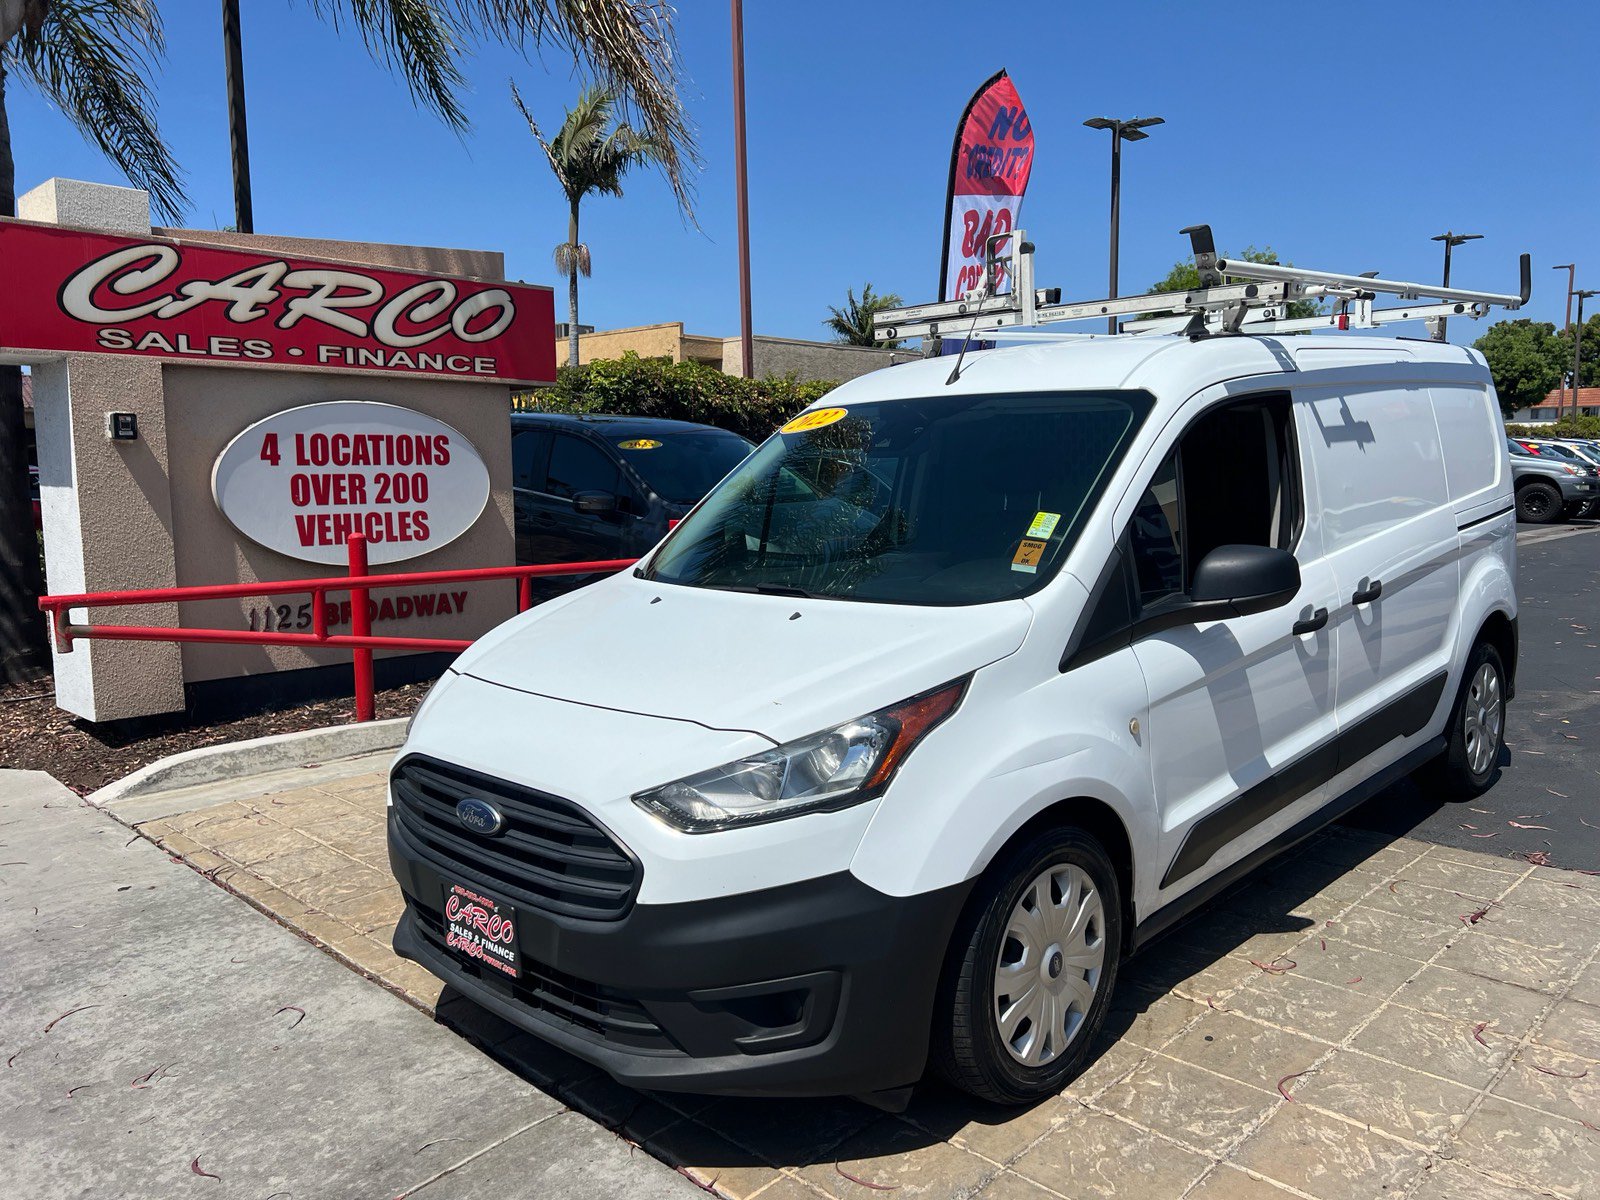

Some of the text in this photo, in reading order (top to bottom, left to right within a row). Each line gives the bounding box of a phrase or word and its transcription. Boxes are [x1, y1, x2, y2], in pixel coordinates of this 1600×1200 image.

[988, 105, 1031, 141] NO
[962, 208, 1011, 258] BAD
[59, 243, 517, 348] CARCO
[97, 329, 497, 374] SALES FINANCE
[261, 433, 450, 466] 4 LOCATIONS
[290, 472, 429, 507] OVER 200
[295, 510, 430, 547] VEHICLES
[250, 602, 311, 632] 1125
[462, 804, 487, 827] Ford
[445, 894, 514, 943] CARCO
[450, 923, 515, 962] SALES & FINANCE
